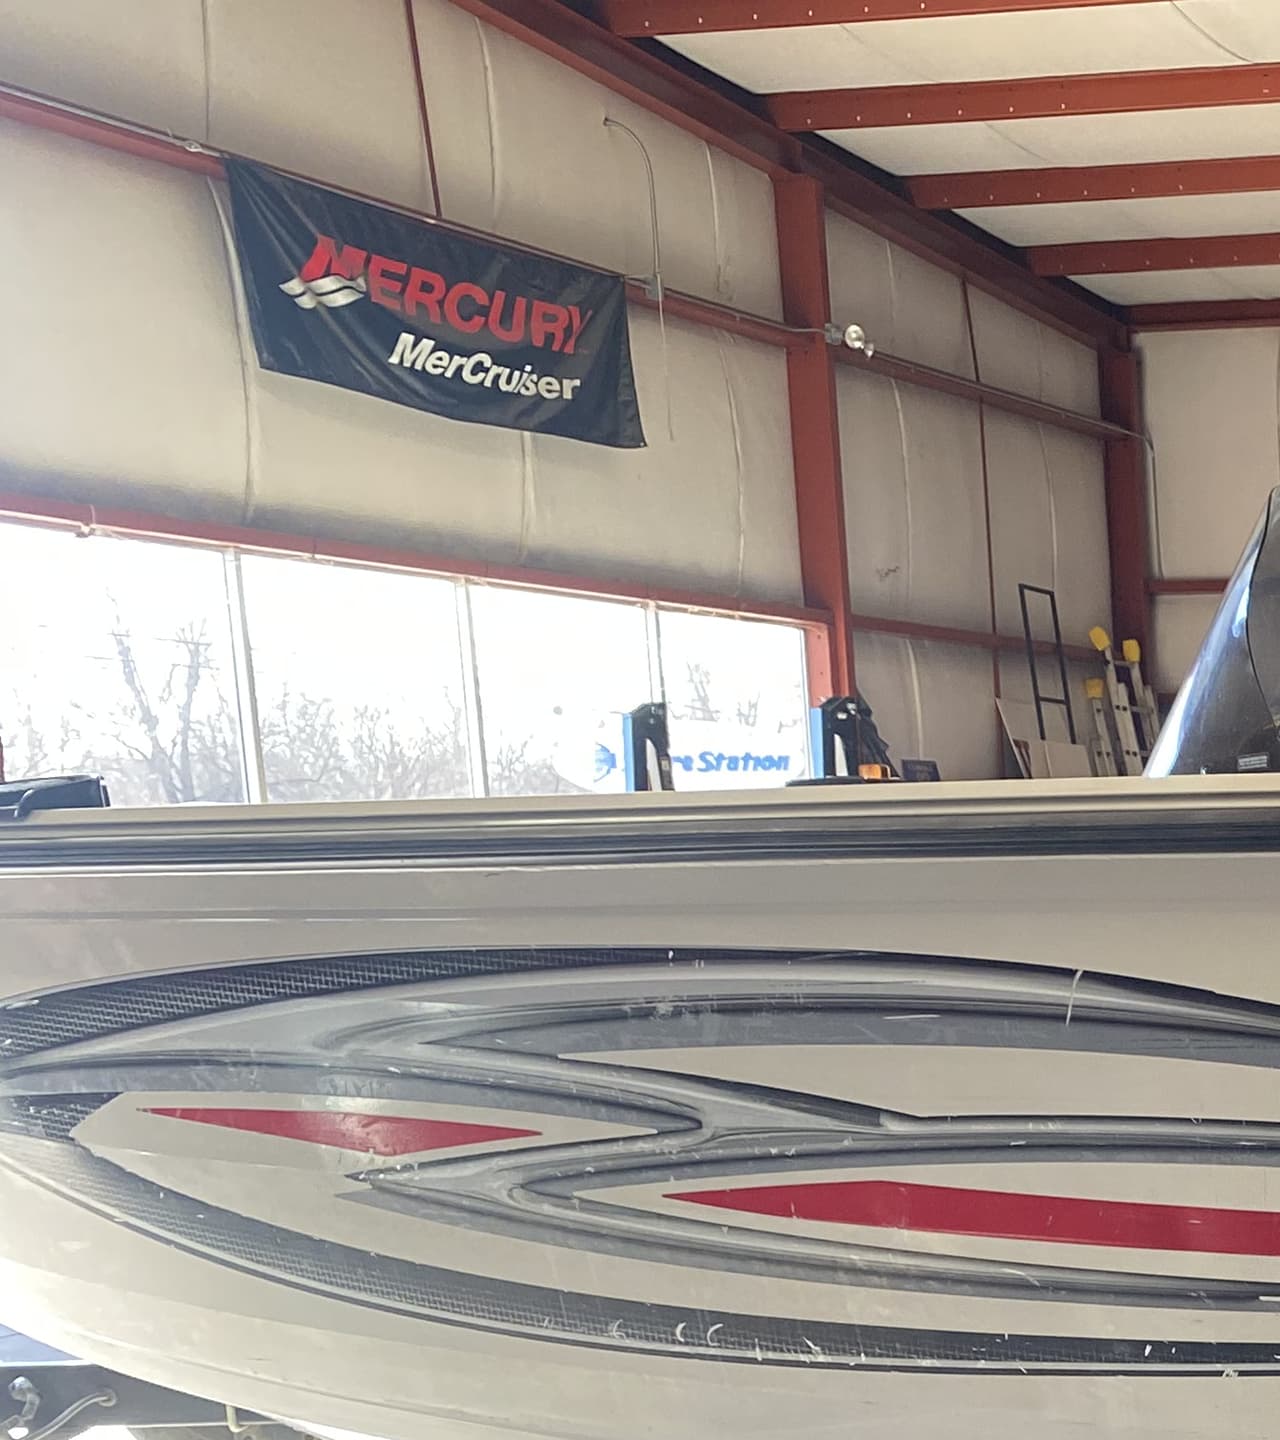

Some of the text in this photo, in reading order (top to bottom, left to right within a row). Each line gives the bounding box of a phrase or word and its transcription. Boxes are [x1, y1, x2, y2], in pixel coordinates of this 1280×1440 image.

[300, 234, 593, 354] MERCURY
[388, 332, 581, 400] MerCruiser
[697, 751, 790, 772] Station
